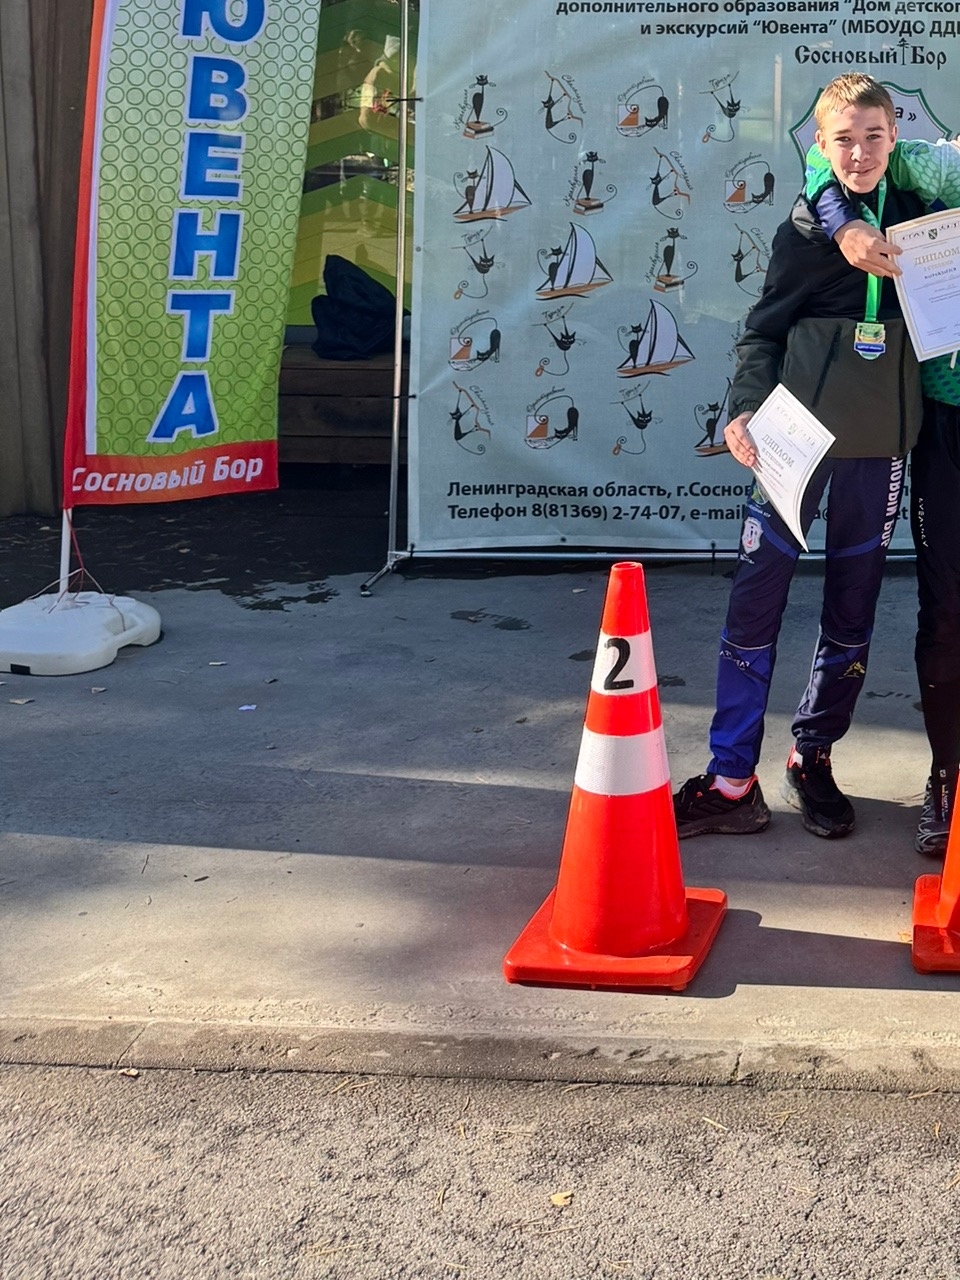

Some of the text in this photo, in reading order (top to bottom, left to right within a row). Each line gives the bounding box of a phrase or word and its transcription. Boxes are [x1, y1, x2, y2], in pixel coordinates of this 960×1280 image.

[556, 0, 719, 15] дополнительного
[640, 24, 651, 35] и
[655, 20, 748, 38] экскурсий
[795, 44, 947, 70] Сосновый Бор
[914, 245, 960, 266] ДИПЛОМ
[761, 433, 795, 469] ДИПЛОМ
[72, 455, 263, 492] Сосновый Бор
[447, 480, 753, 500] Ленинградская область, г.Соснов
[448, 502, 527, 521] Телефон
[531, 502, 608, 521] 8(81369)
[602, 636, 635, 691] 2
